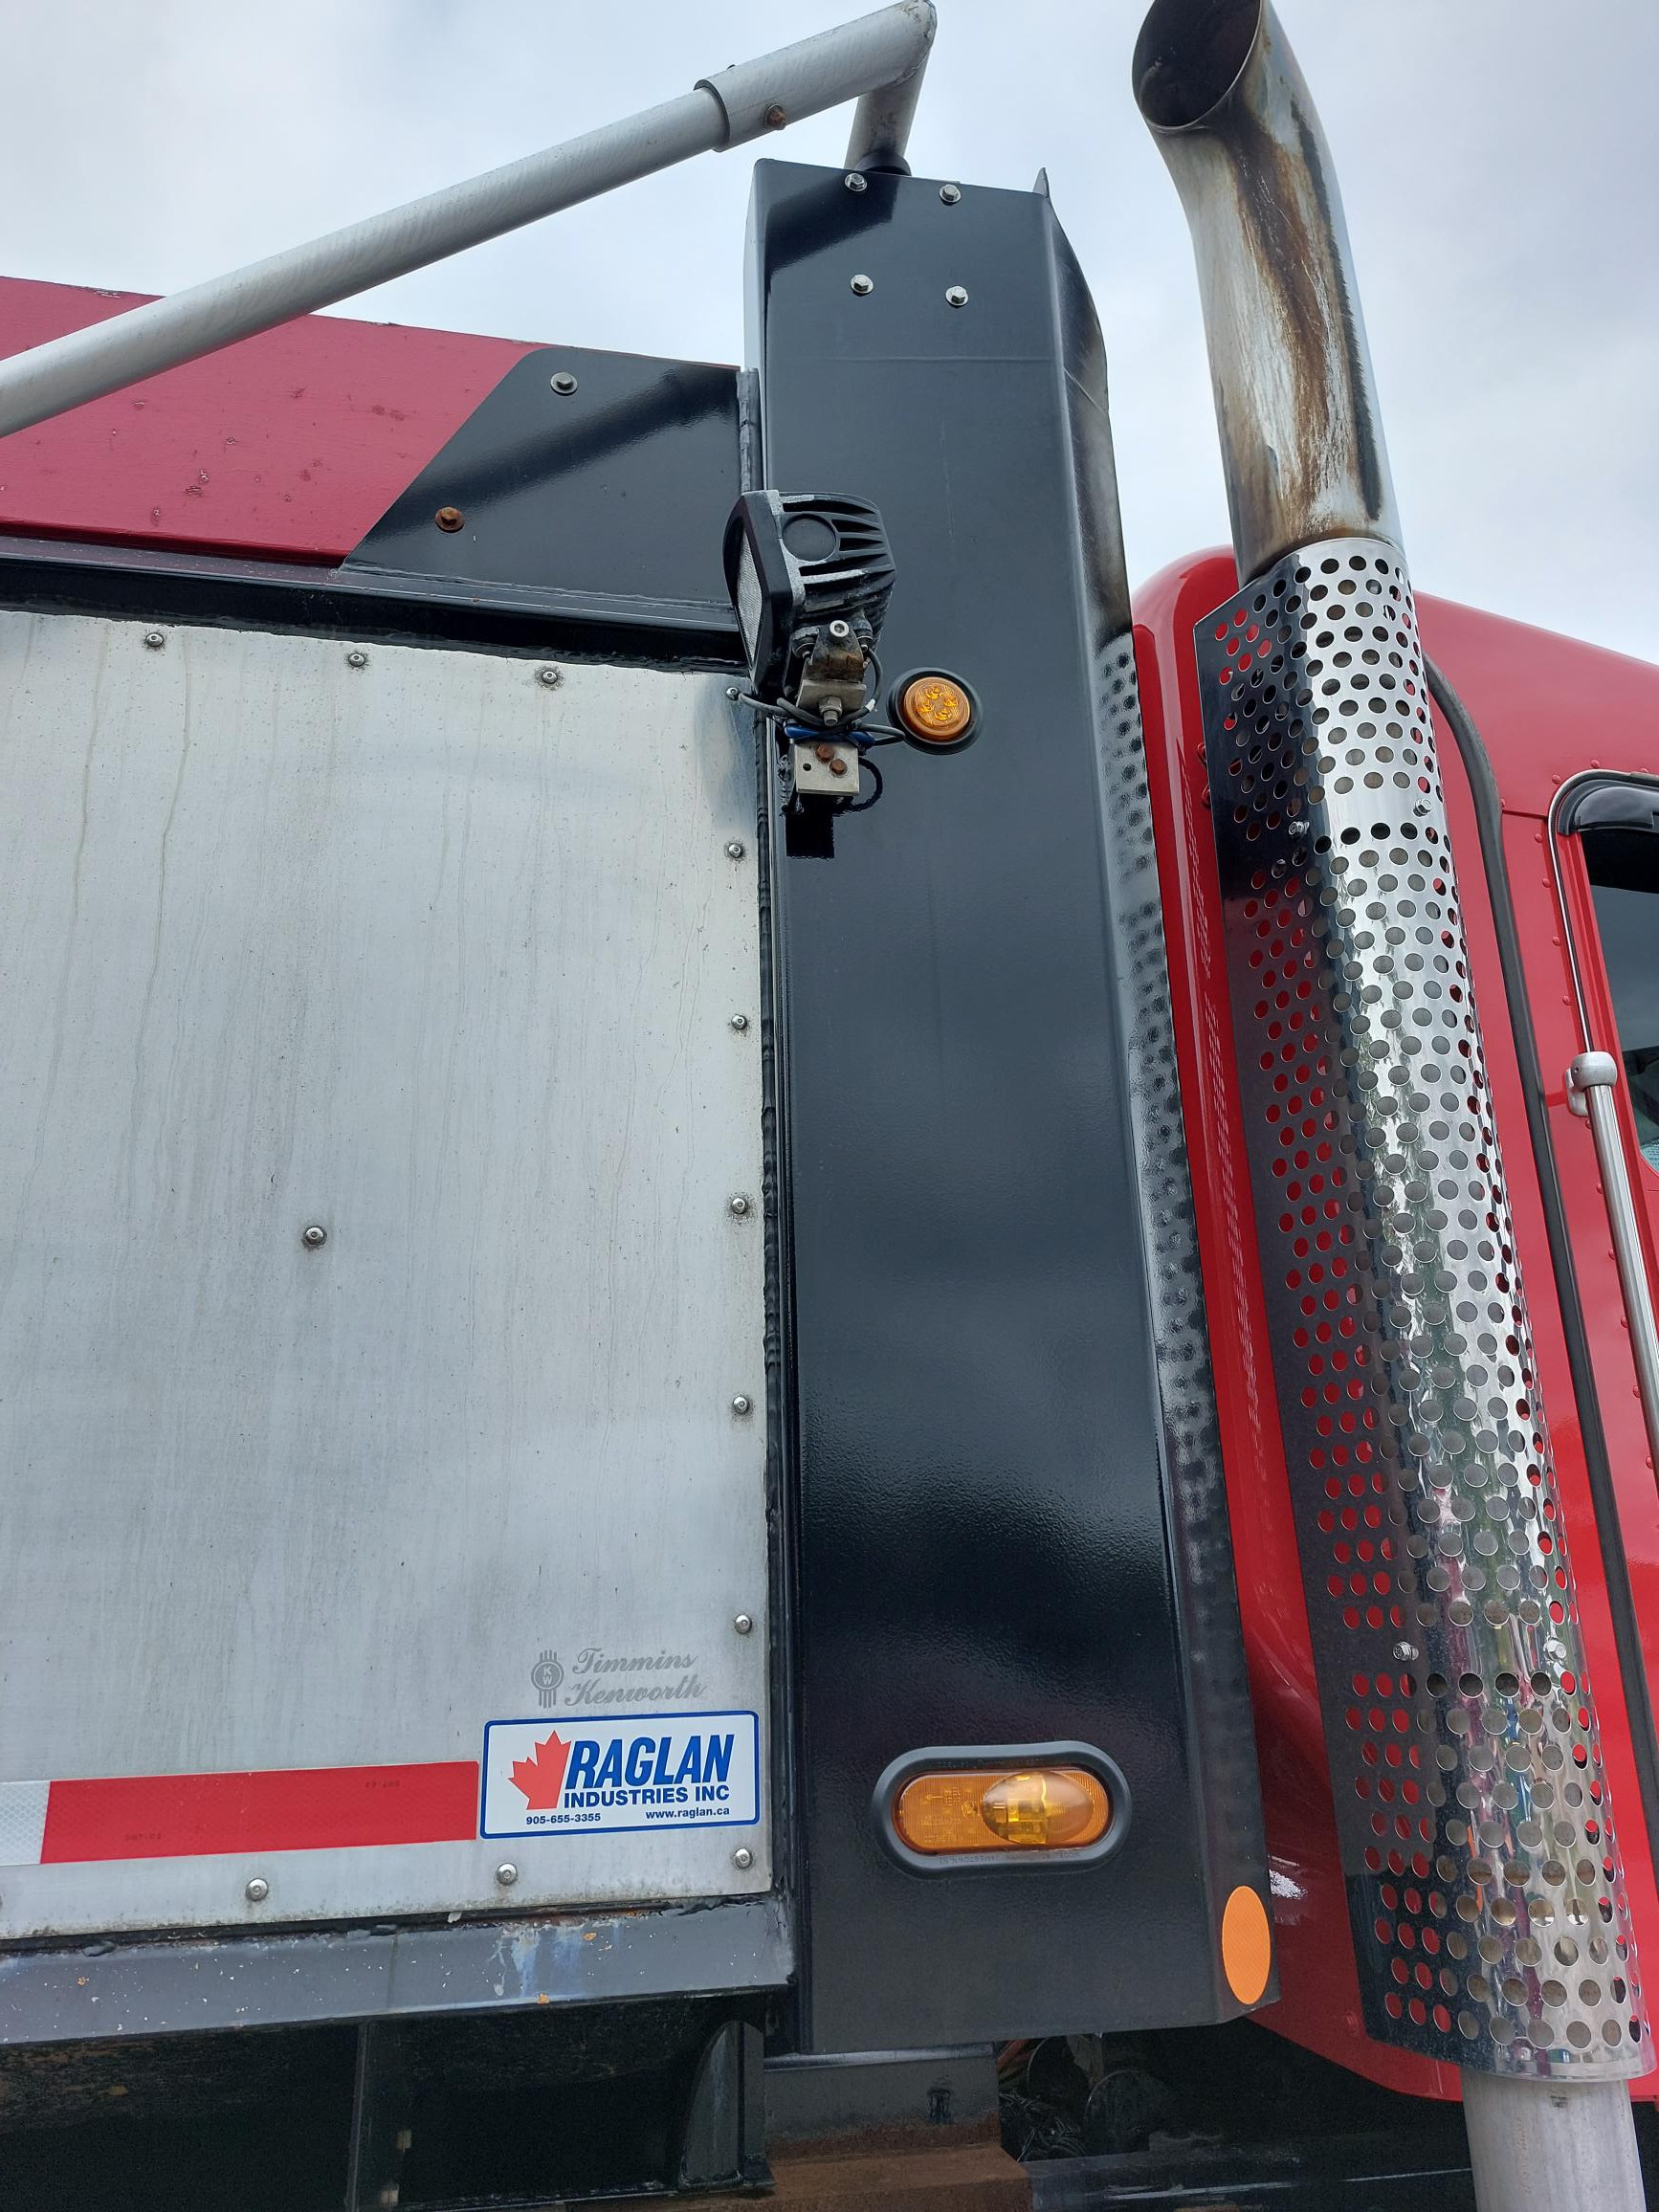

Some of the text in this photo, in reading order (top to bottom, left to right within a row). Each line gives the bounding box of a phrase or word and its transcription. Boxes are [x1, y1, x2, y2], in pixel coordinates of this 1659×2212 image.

[571, 1647, 698, 1674] Timmins
[564, 1674, 708, 1707] Kenworth
[565, 1734, 735, 1790] RAGLAN
[564, 1785, 730, 1808] INDUSTRIES INC
[525, 1807, 730, 1825] 905-655-3355 www.raglan.ca
